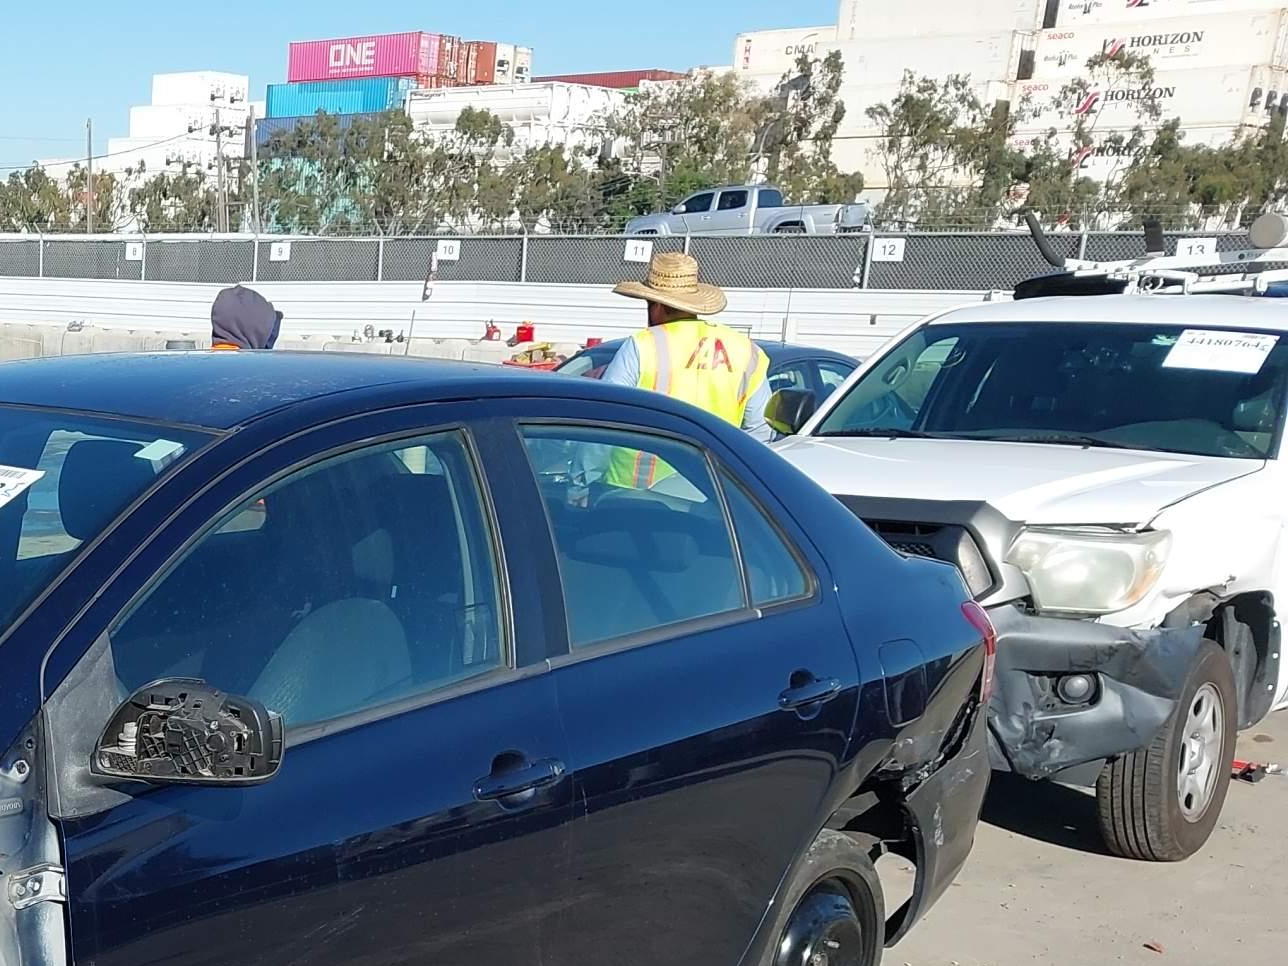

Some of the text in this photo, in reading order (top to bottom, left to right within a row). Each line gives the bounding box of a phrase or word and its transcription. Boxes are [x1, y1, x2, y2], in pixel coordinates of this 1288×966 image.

[1047, 32, 1075, 41] seaco
[1130, 31, 1204, 48] HORIZON
[329, 42, 375, 67] ONE
[1022, 83, 1049, 92] seaco
[1104, 87, 1176, 102] HORIZON
[277, 247, 283, 257] 9
[442, 245, 454, 255] 10
[633, 246, 645, 256] 11
[881, 244, 897, 257] 12
